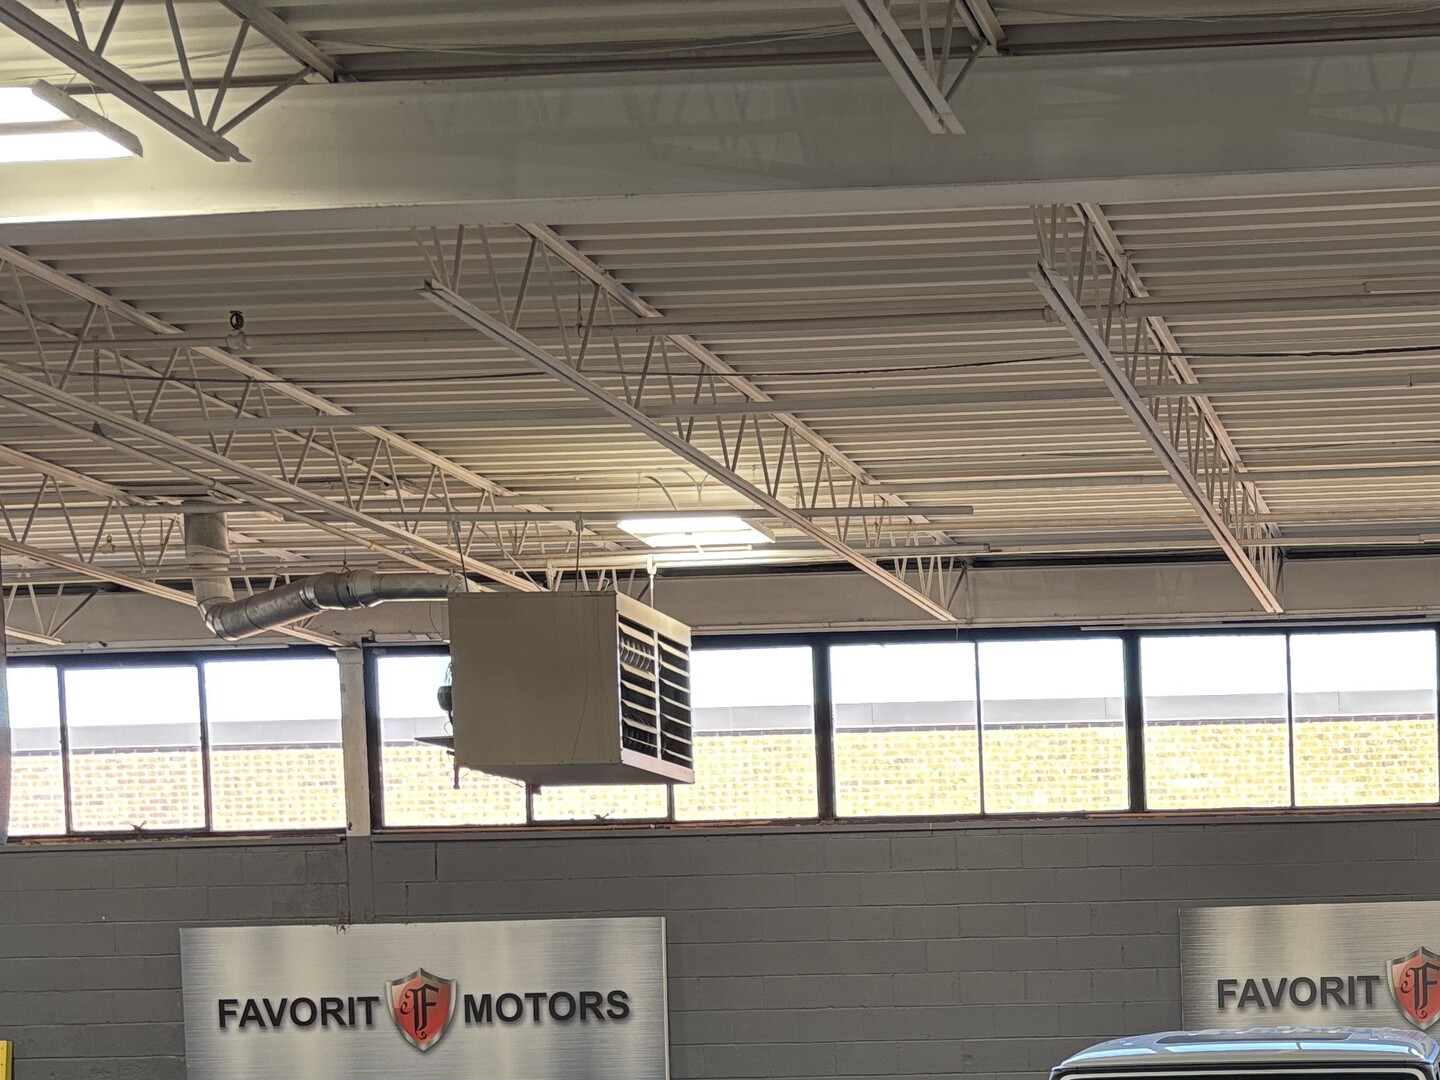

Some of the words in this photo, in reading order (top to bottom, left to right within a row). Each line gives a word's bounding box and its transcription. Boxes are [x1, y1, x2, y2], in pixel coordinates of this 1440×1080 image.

[218, 996, 379, 1028] FAVORIT
[464, 990, 630, 1024] MOTORS
[1217, 975, 1380, 1010] FAVORIT
